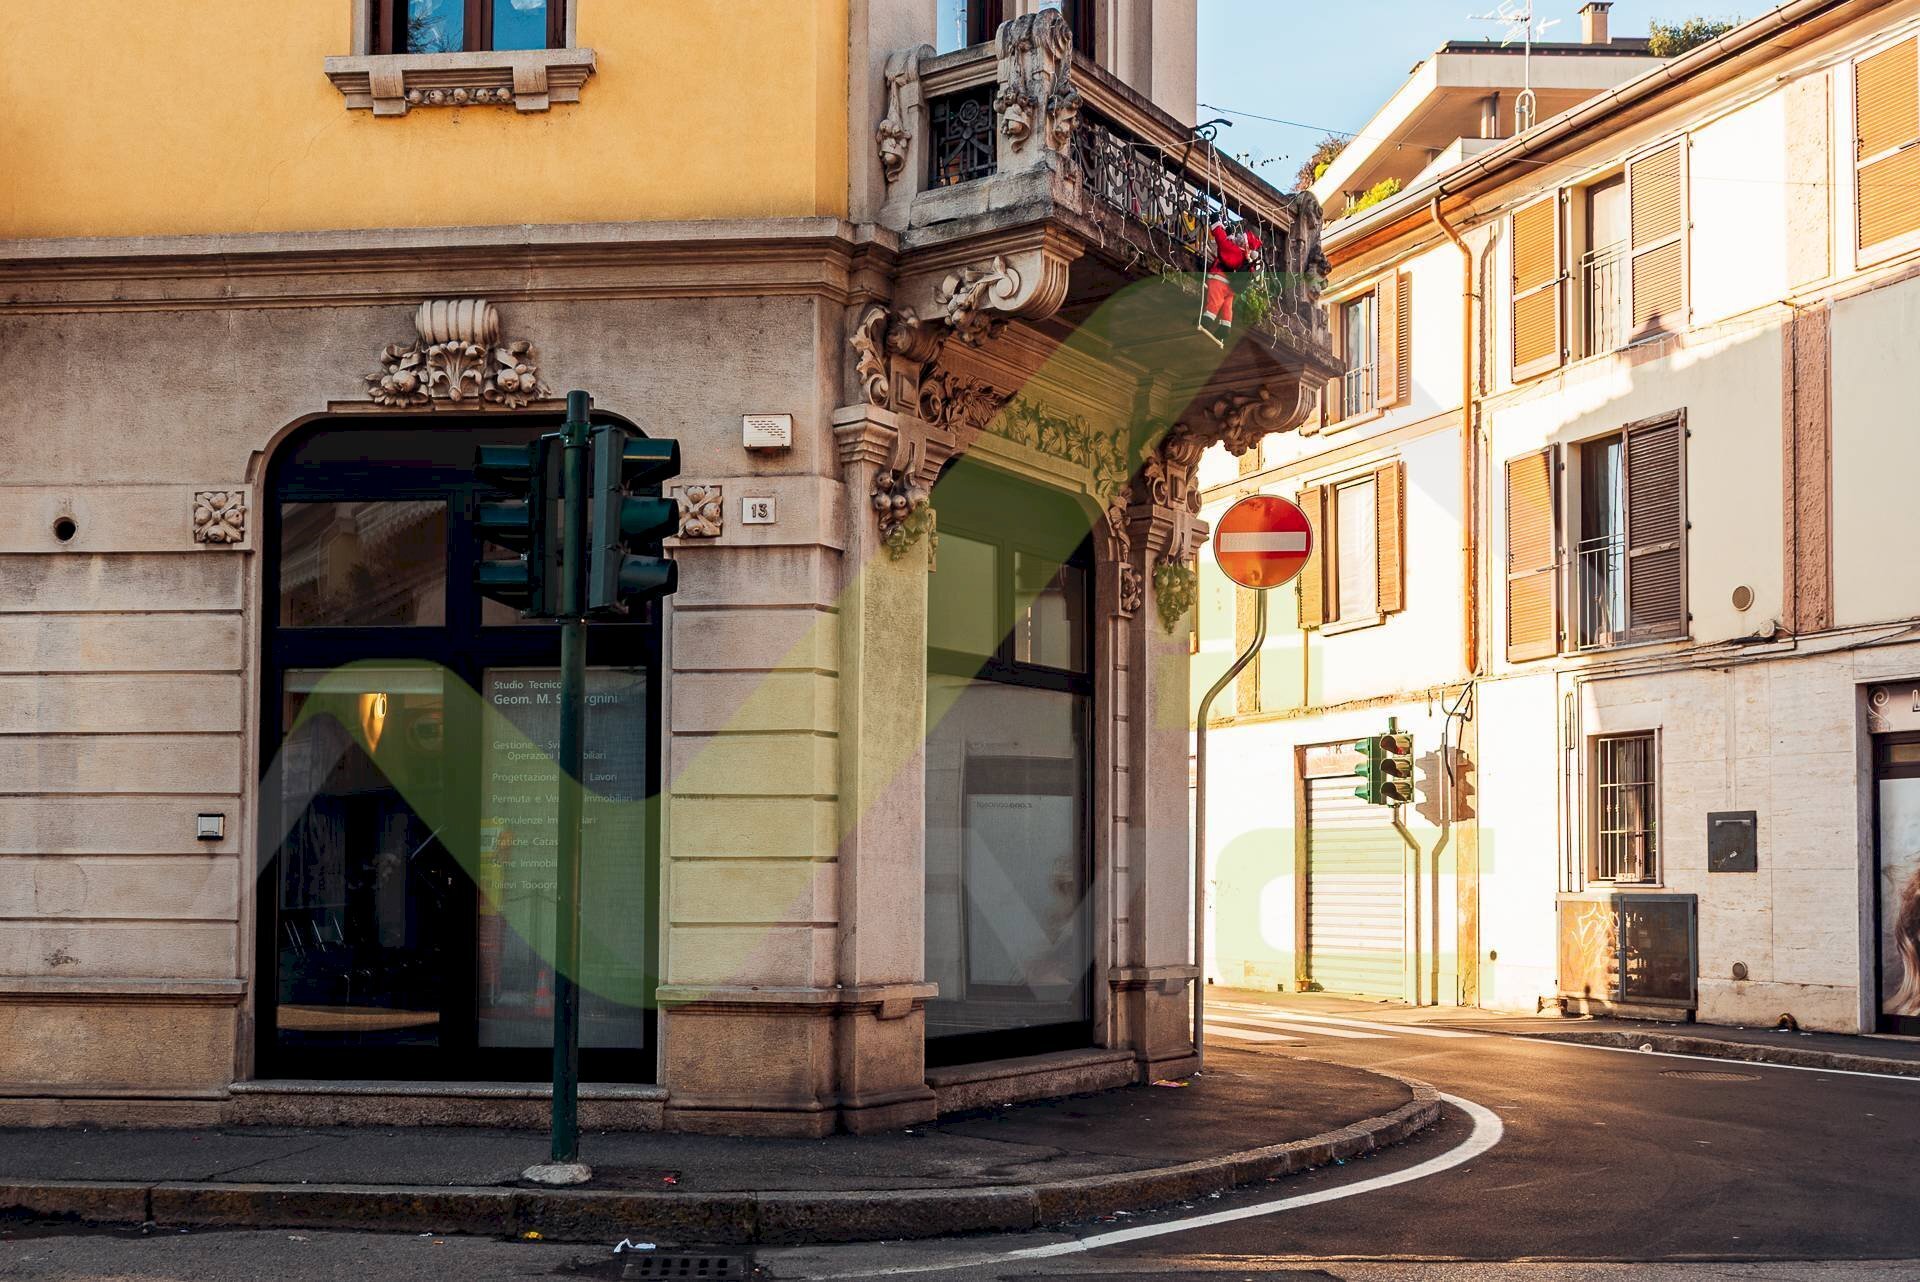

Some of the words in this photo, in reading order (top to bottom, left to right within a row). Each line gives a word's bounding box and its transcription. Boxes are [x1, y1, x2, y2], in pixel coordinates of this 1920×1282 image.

[751, 503, 768, 518] 13
[494, 680, 524, 690] Studio
[494, 694, 532, 705] Geom.
[536, 694, 551, 704] M.
[555, 694, 618, 706] Srgnini
[493, 741, 533, 750] Gestione
[590, 773, 617, 782] Lavori
[492, 794, 530, 803] Permuta
[584, 794, 633, 803] Immobiliari
[492, 816, 543, 825] Consulenze
[492, 837, 529, 846] Pratiche
[532, 837, 558, 846] Catas
[520, 859, 558, 868] Immobili
[522, 880, 558, 891] Topogra
